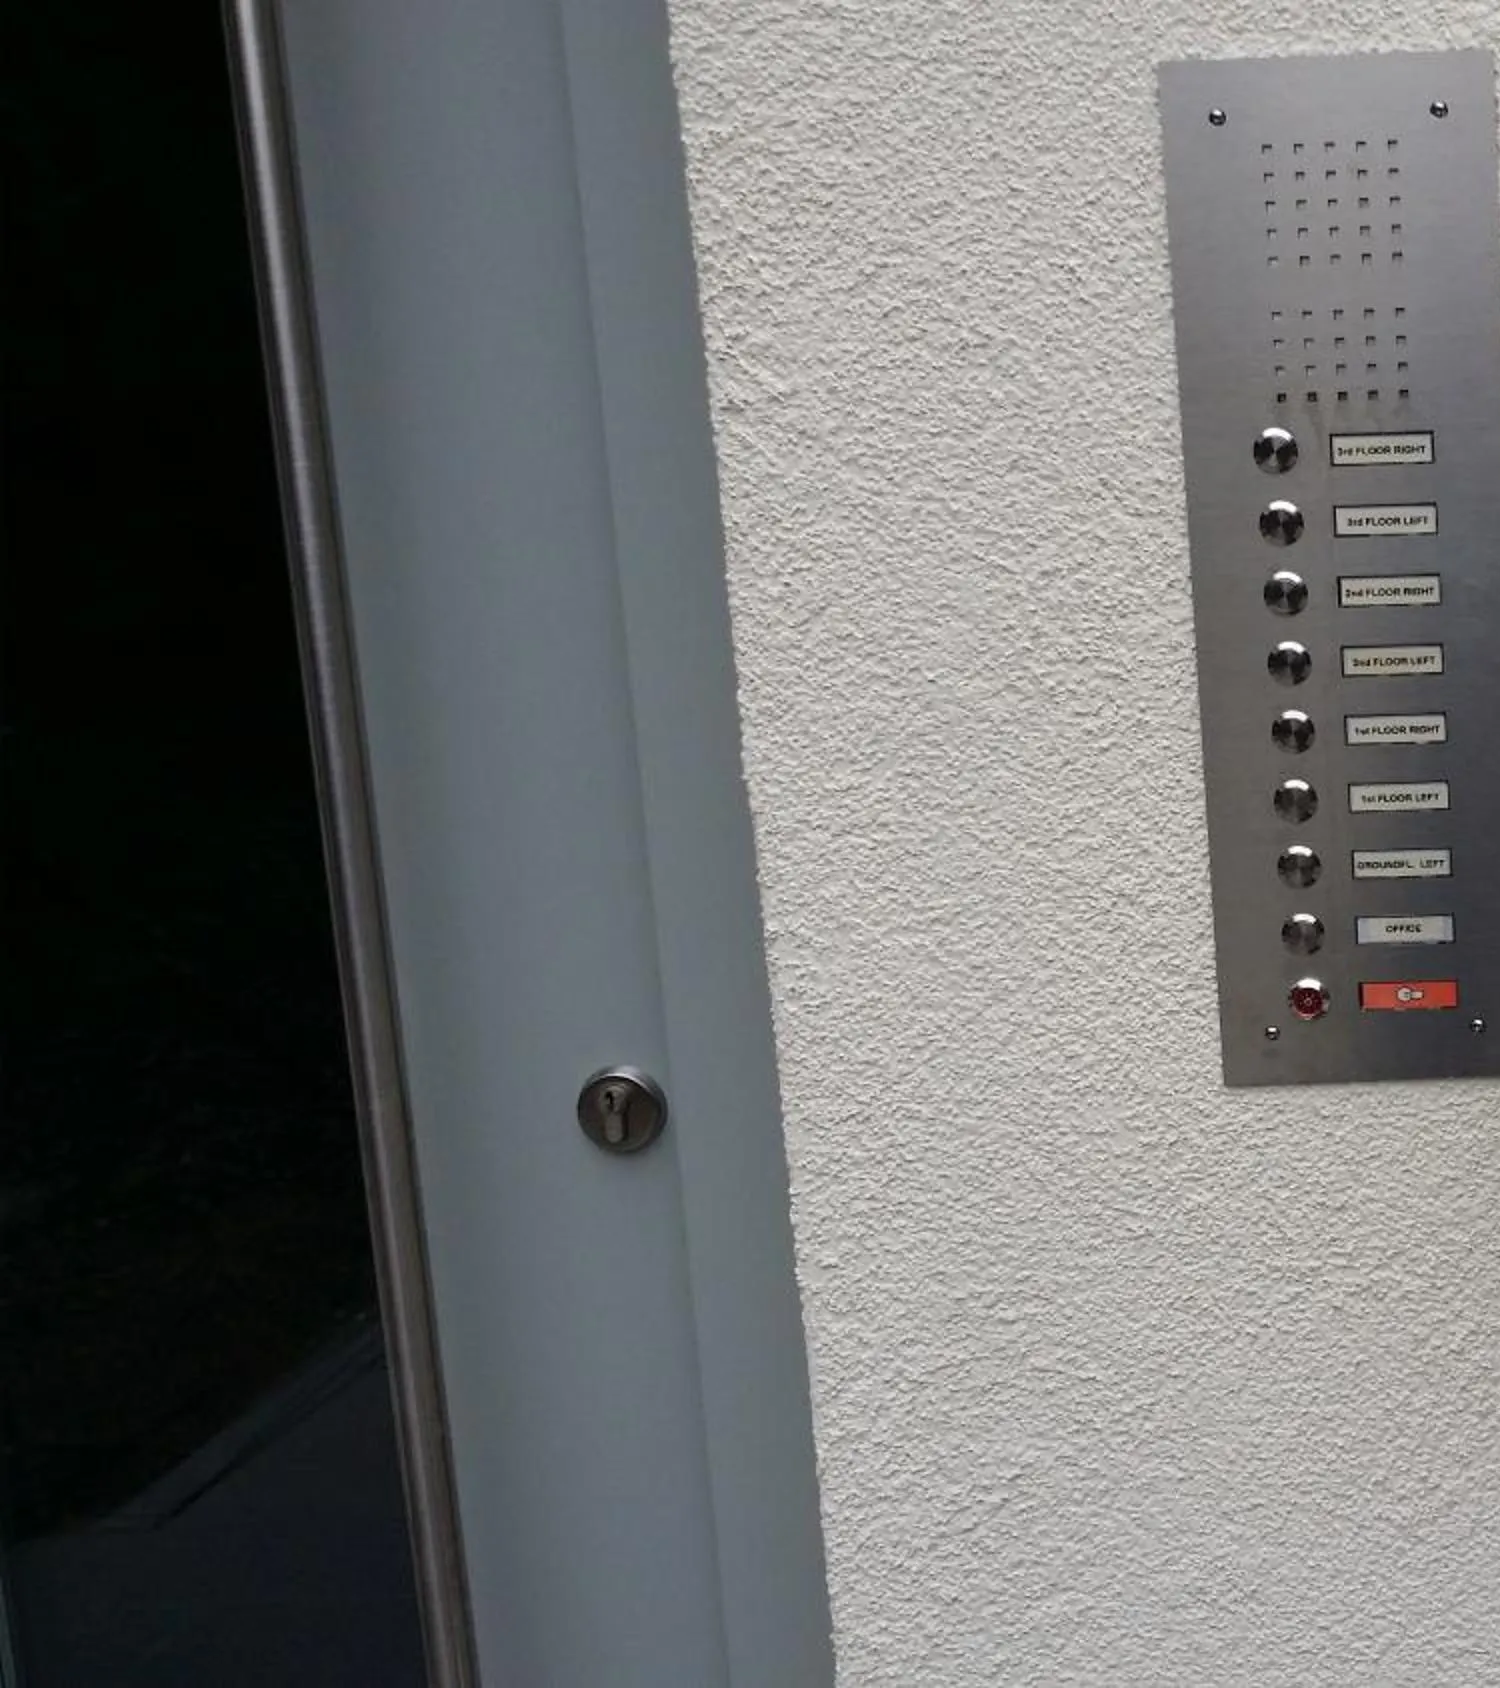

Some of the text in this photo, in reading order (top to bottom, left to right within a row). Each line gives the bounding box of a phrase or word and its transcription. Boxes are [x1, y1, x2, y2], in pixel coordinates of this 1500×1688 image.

[1355, 445, 1391, 456] FLOOR
[1393, 444, 1427, 455] RIGHT
[1365, 516, 1402, 527] FLOOR
[1403, 516, 1429, 526] LEFT
[1365, 587, 1401, 598] FLOOR
[1403, 586, 1435, 597] RIGHT
[1372, 656, 1409, 667] FLOOR
[1409, 655, 1436, 666] LEFT
[1371, 725, 1407, 735] FLOOR
[1409, 724, 1441, 735] RIGHT
[1377, 793, 1413, 803] FLOOR
[1415, 793, 1439, 802] LEFT
[1419, 859, 1445, 869] LEFT
[1385, 923, 1422, 934] OFFICE
